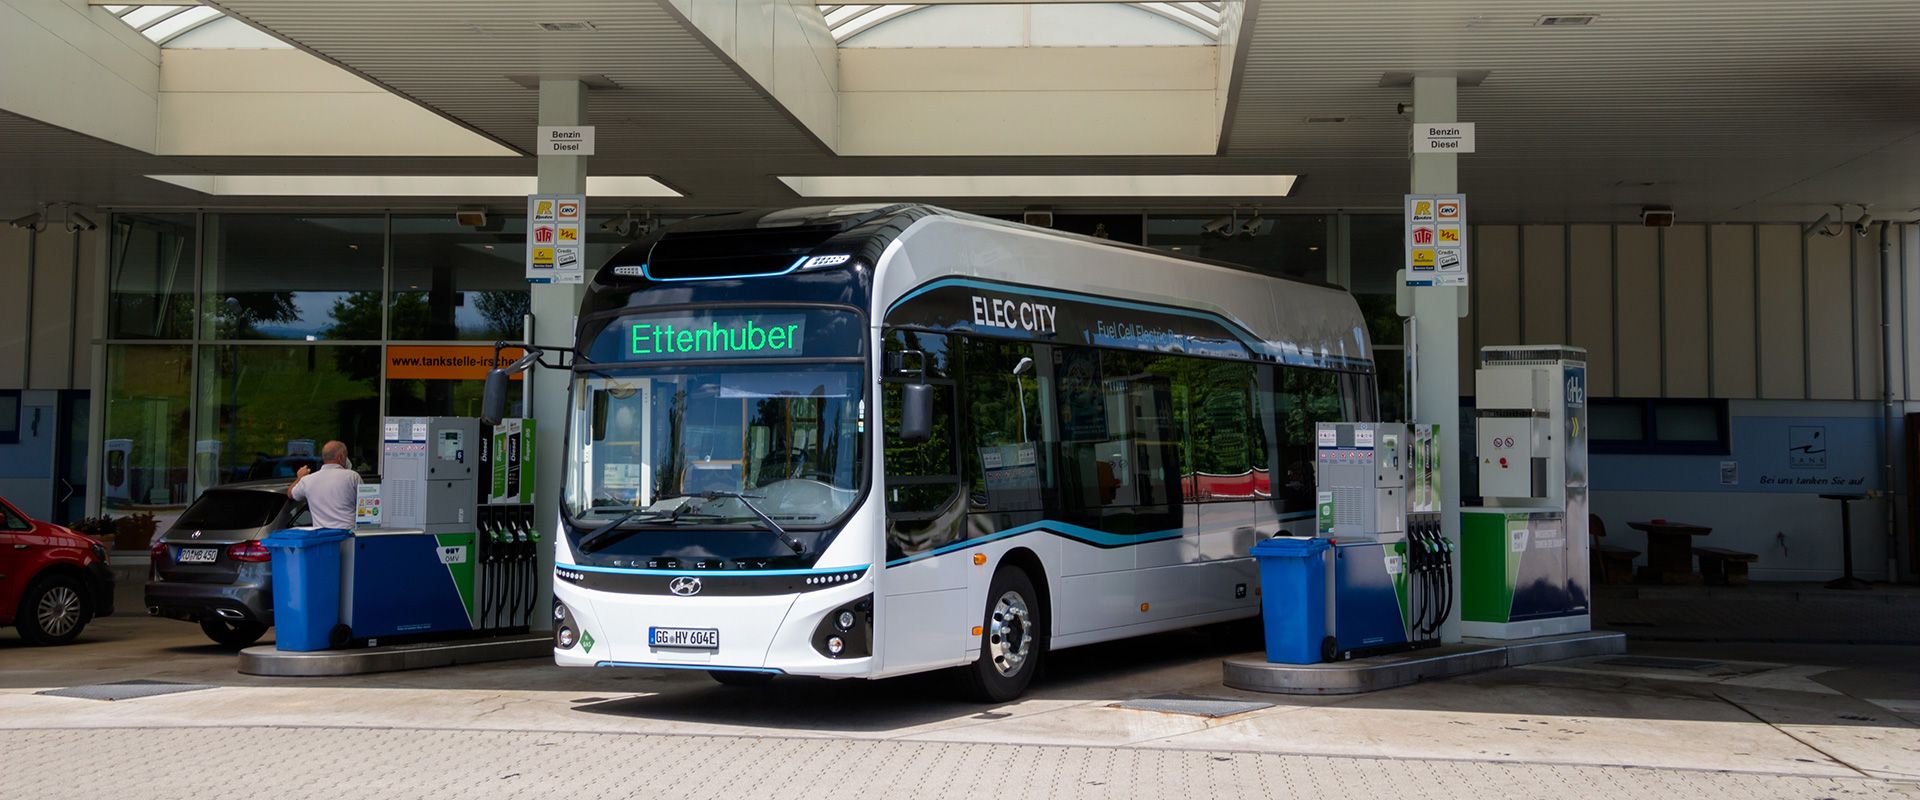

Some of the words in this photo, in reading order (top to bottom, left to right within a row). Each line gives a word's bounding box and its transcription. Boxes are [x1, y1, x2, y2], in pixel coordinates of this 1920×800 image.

[552, 130, 581, 139] Benzin
[1429, 127, 1460, 136] Benzin
[553, 143, 579, 151] Diesel
[1431, 140, 1459, 149] Diesel
[535, 226, 553, 243] UTA
[1414, 227, 1433, 244] UTA
[971, 296, 1017, 328] ELEC
[1020, 302, 1057, 333] CITY
[632, 321, 798, 354] Ettenhuber
[1097, 320, 1116, 339] Fuel
[1118, 323, 1135, 341] Cell
[1136, 325, 1167, 344] Electric
[1760, 475, 1775, 485] Bei
[1777, 477, 1793, 485] uns
[1796, 476, 1829, 485] tanken
[1831, 476, 1845, 485] Sie
[1848, 476, 1865, 486] auf
[203, 551, 216, 560] 450
[696, 561, 768, 569] CITY
[656, 630, 669, 644] GG
[675, 631, 688, 644] HY
[690, 632, 716, 645] 604E
